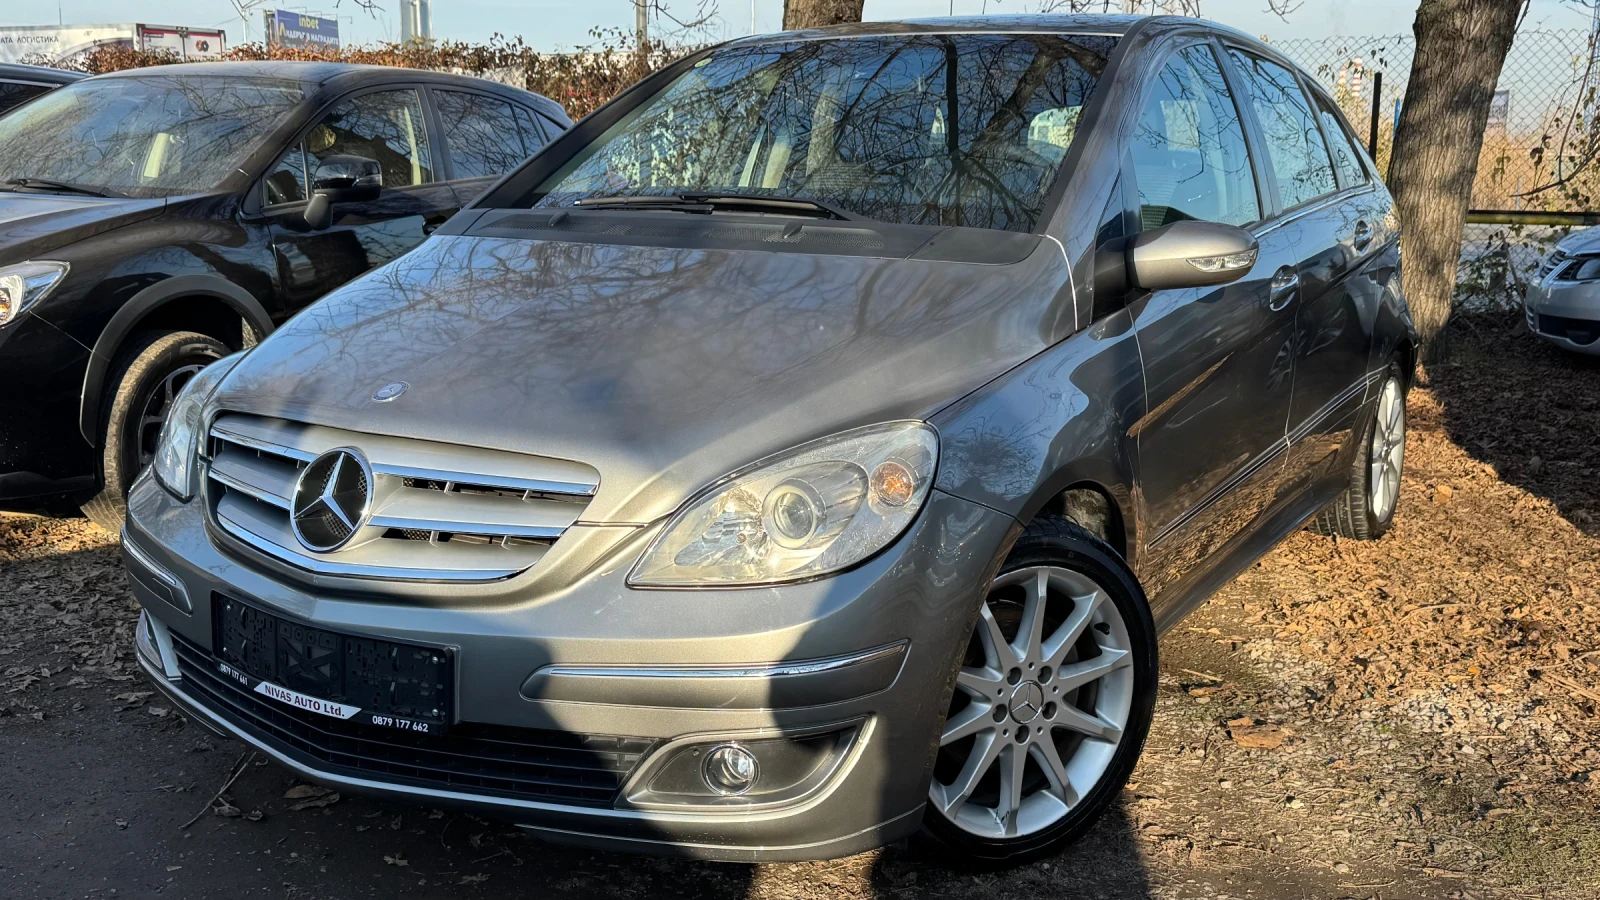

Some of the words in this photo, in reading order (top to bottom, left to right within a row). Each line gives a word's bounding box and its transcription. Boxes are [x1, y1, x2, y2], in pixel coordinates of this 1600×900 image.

[298, 14, 319, 29] inbet
[220, 663, 231, 675] 0879
[231, 669, 240, 680] 177
[240, 674, 248, 686] 661
[264, 684, 292, 702] NIVAS
[294, 695, 321, 711] AUTO
[323, 703, 345, 717] Ltd.
[372, 715, 393, 727] 0879
[395, 719, 410, 730] 177
[412, 722, 429, 733] 662
